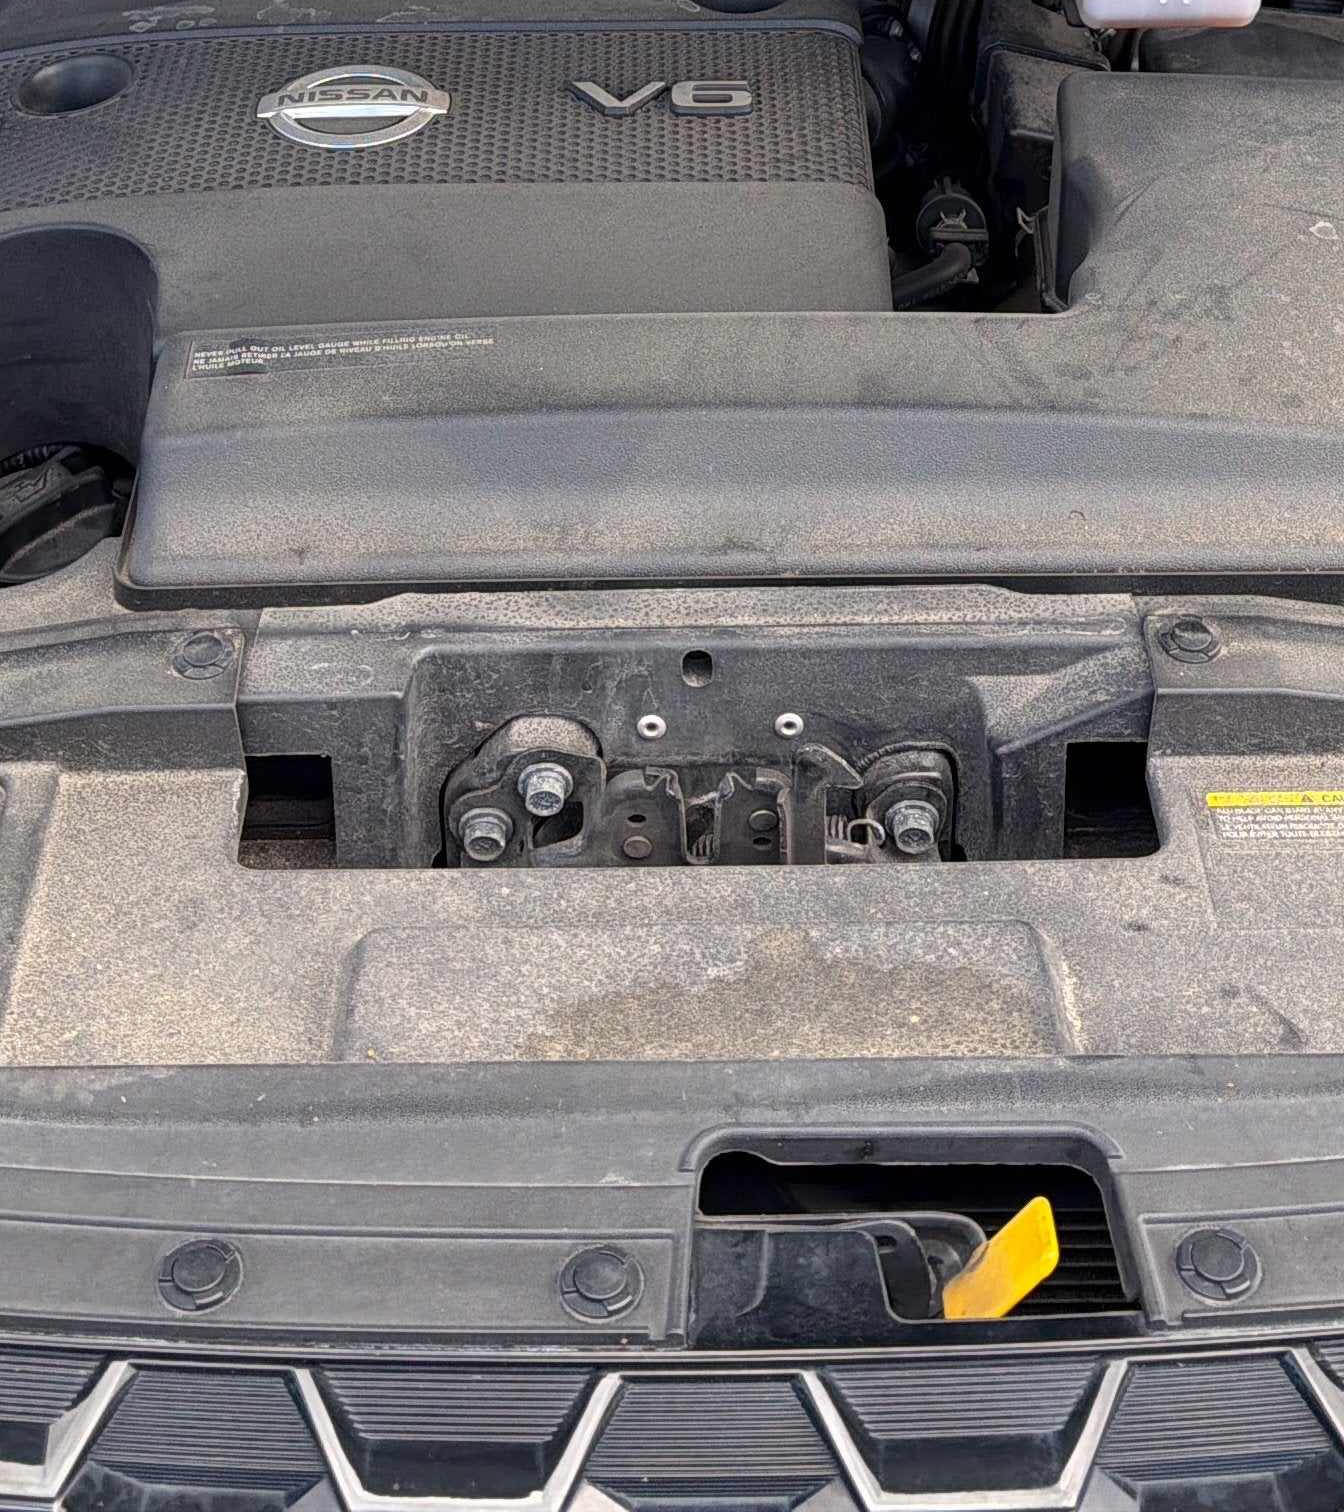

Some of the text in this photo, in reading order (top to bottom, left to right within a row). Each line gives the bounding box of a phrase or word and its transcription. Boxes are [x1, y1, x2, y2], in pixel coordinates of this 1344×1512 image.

[277, 88, 429, 107] NISSAN
[569, 80, 753, 114] V6
[193, 357, 205, 365] NE
[208, 353, 239, 363] JAMAIS
[280, 350, 292, 358] LA
[324, 348, 337, 356] DE
[340, 345, 372, 354] NIVEAU
[194, 350, 224, 358] NEVER
[226, 345, 248, 355] PULL
[250, 345, 269, 353] OUT
[271, 345, 287, 353] OIL
[289, 343, 315, 351] LEVEL
[318, 340, 350, 349] GAUGE
[352, 338, 380, 347] WHILE
[382, 336, 416, 344] FILLING
[419, 334, 452, 343] ENGINE
